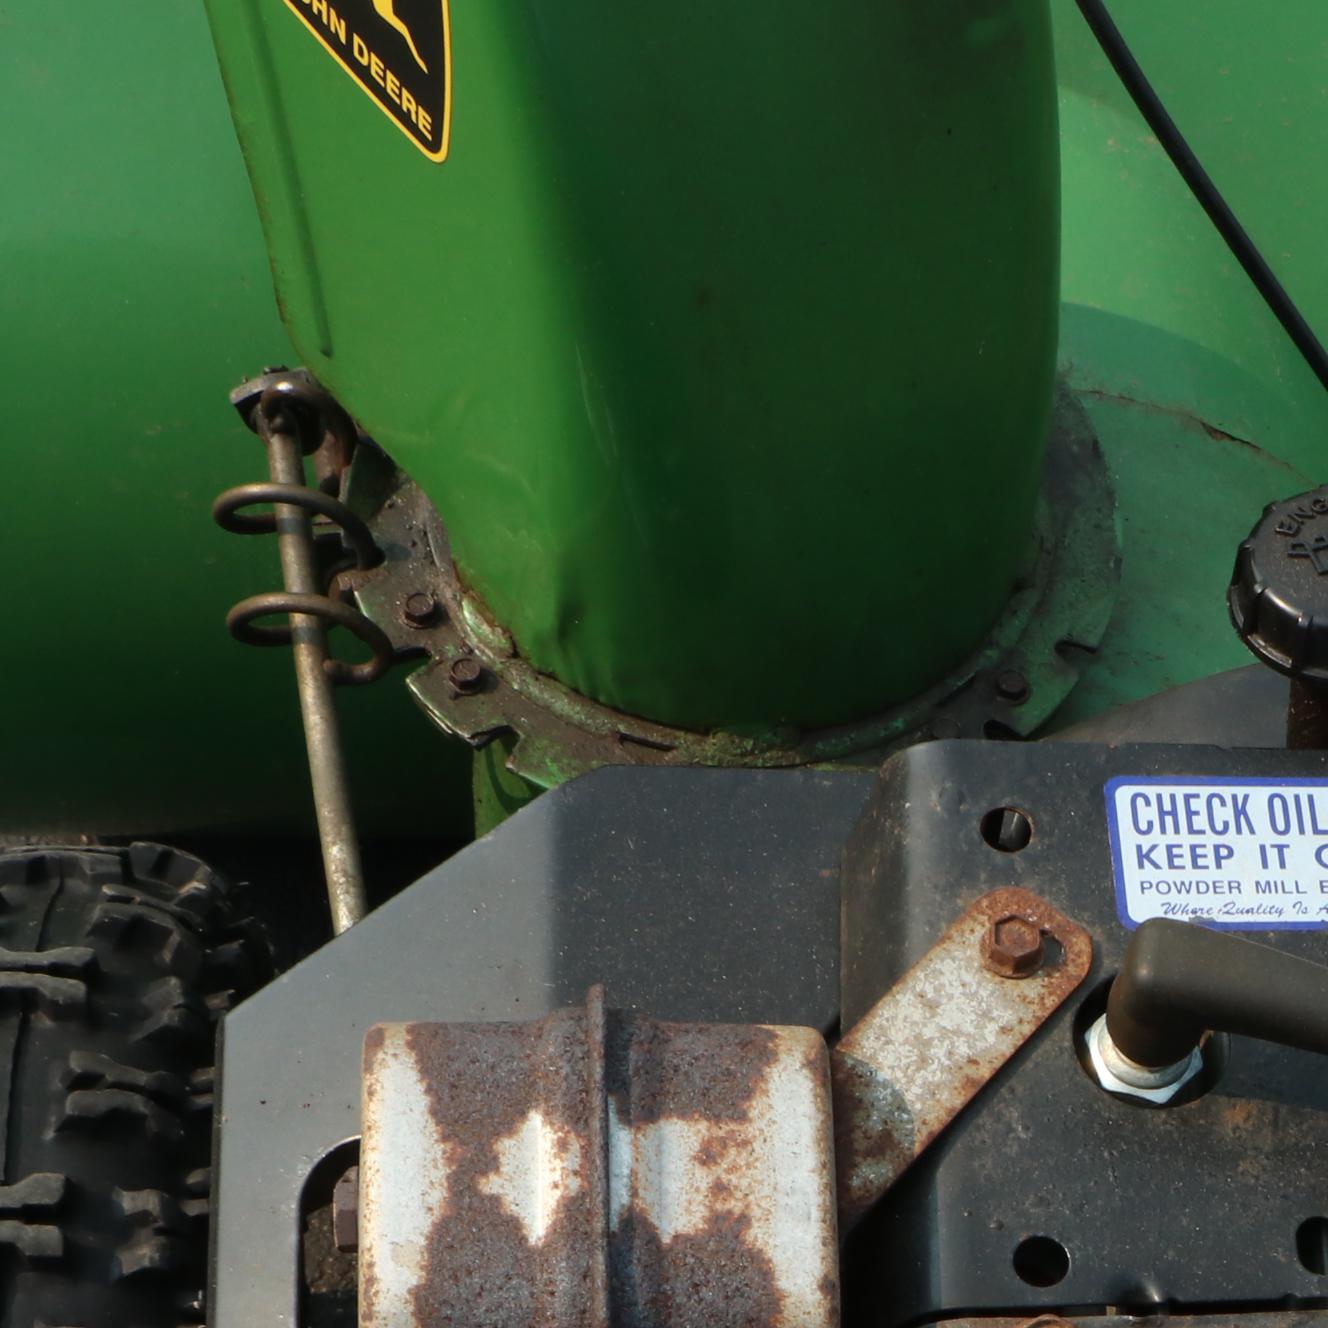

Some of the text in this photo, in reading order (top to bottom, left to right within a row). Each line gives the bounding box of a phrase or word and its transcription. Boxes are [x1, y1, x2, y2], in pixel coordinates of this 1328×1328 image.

[302, 0, 432, 141] HN DEERE
[1130, 792, 1255, 836] CHECK
[1136, 844, 1235, 870] KEEP
[1260, 844, 1290, 870] IT
[1140, 880, 1243, 895] POWDER
[1255, 880, 1307, 895] MILL
[1161, 901, 1214, 916] Where
[1220, 901, 1284, 917] Quality
[1292, 900, 1308, 915] Is
